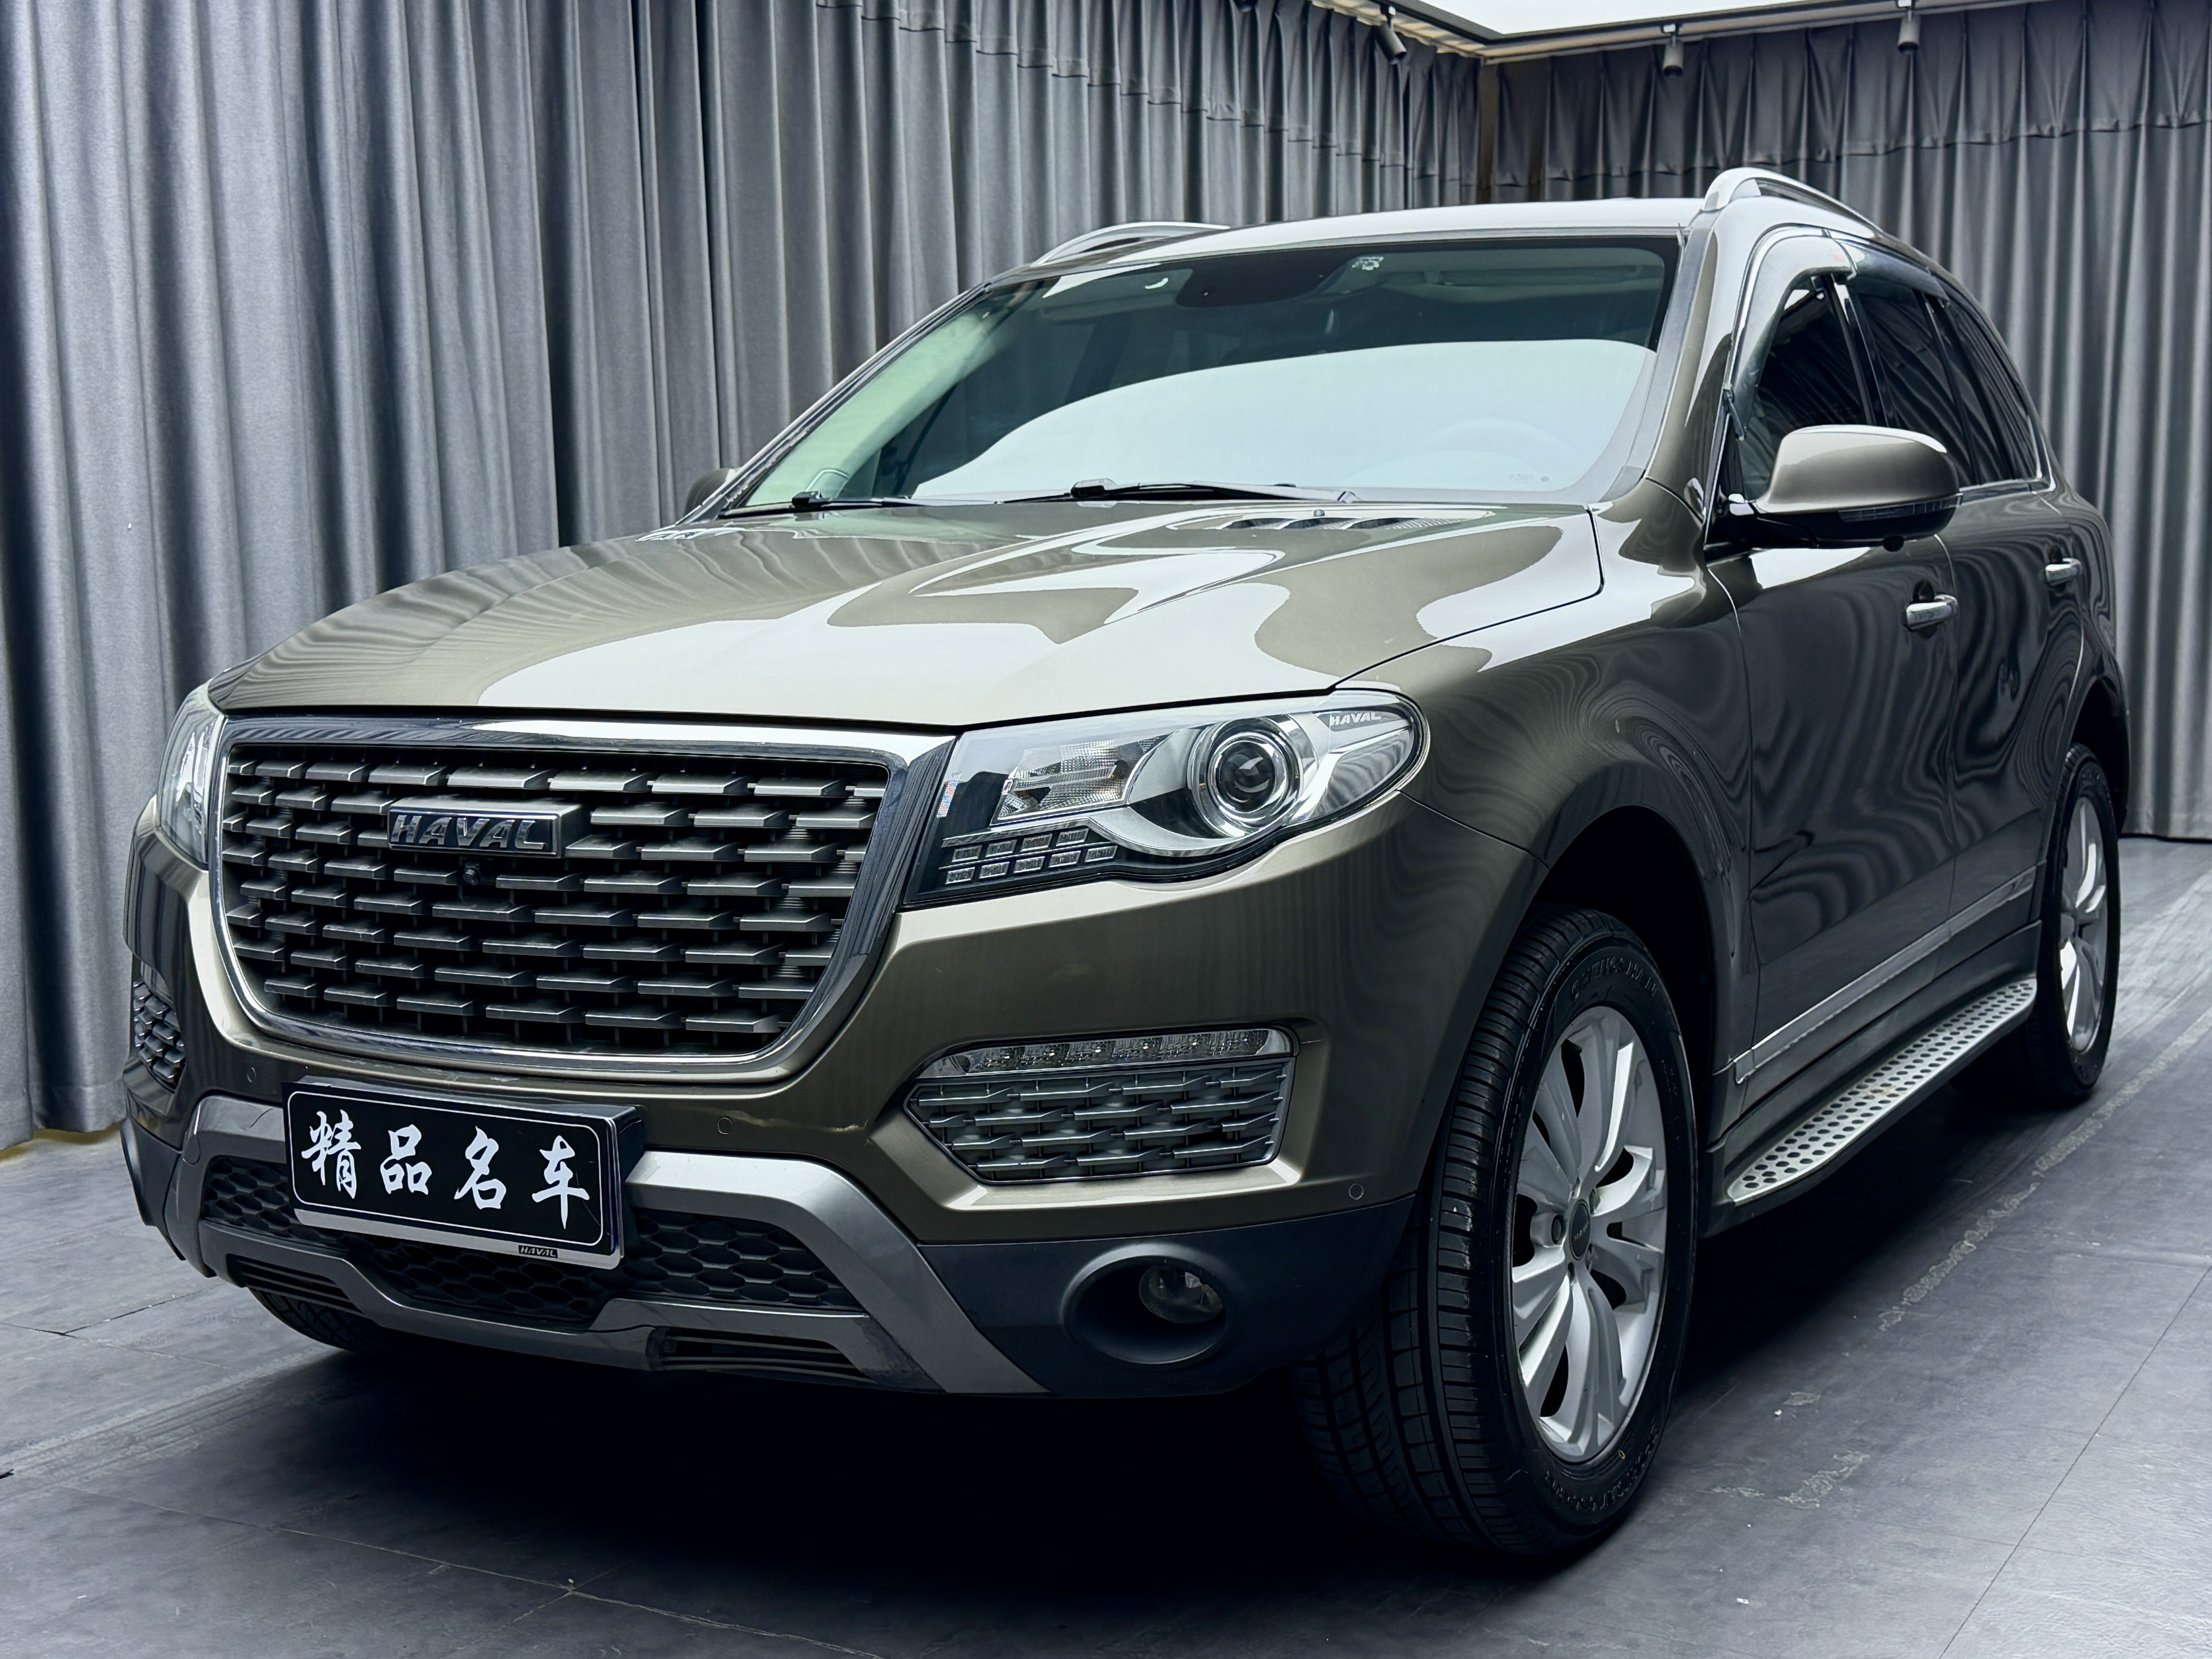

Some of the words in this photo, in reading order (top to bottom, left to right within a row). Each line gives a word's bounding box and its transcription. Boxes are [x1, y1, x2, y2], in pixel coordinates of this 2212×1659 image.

[1330, 711, 1381, 726] HAVAL
[391, 815, 546, 850] HAVAL
[301, 1109, 589, 1230] 精品名车
[520, 1246, 556, 1257] HAVAL
